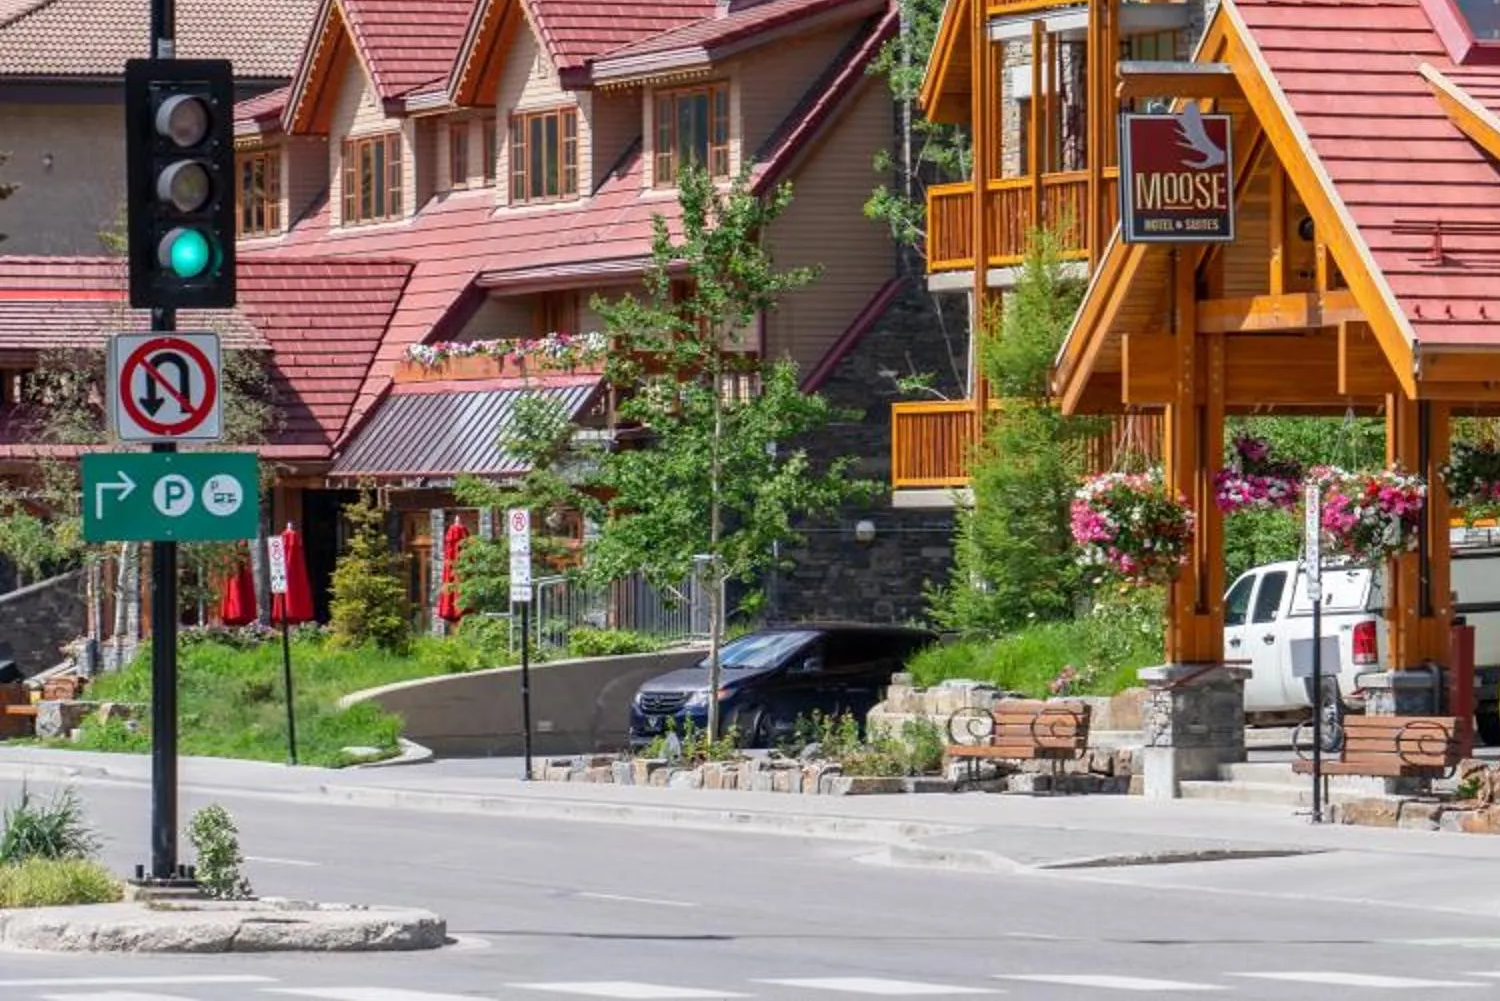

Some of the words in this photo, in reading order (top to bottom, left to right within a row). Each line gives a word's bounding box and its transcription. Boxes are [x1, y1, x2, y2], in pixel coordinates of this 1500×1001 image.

[1136, 172, 1227, 210] MOOSE
[1144, 218, 1174, 231] HOTEL
[1185, 218, 1220, 231] SUITES
[165, 481, 185, 509] P
